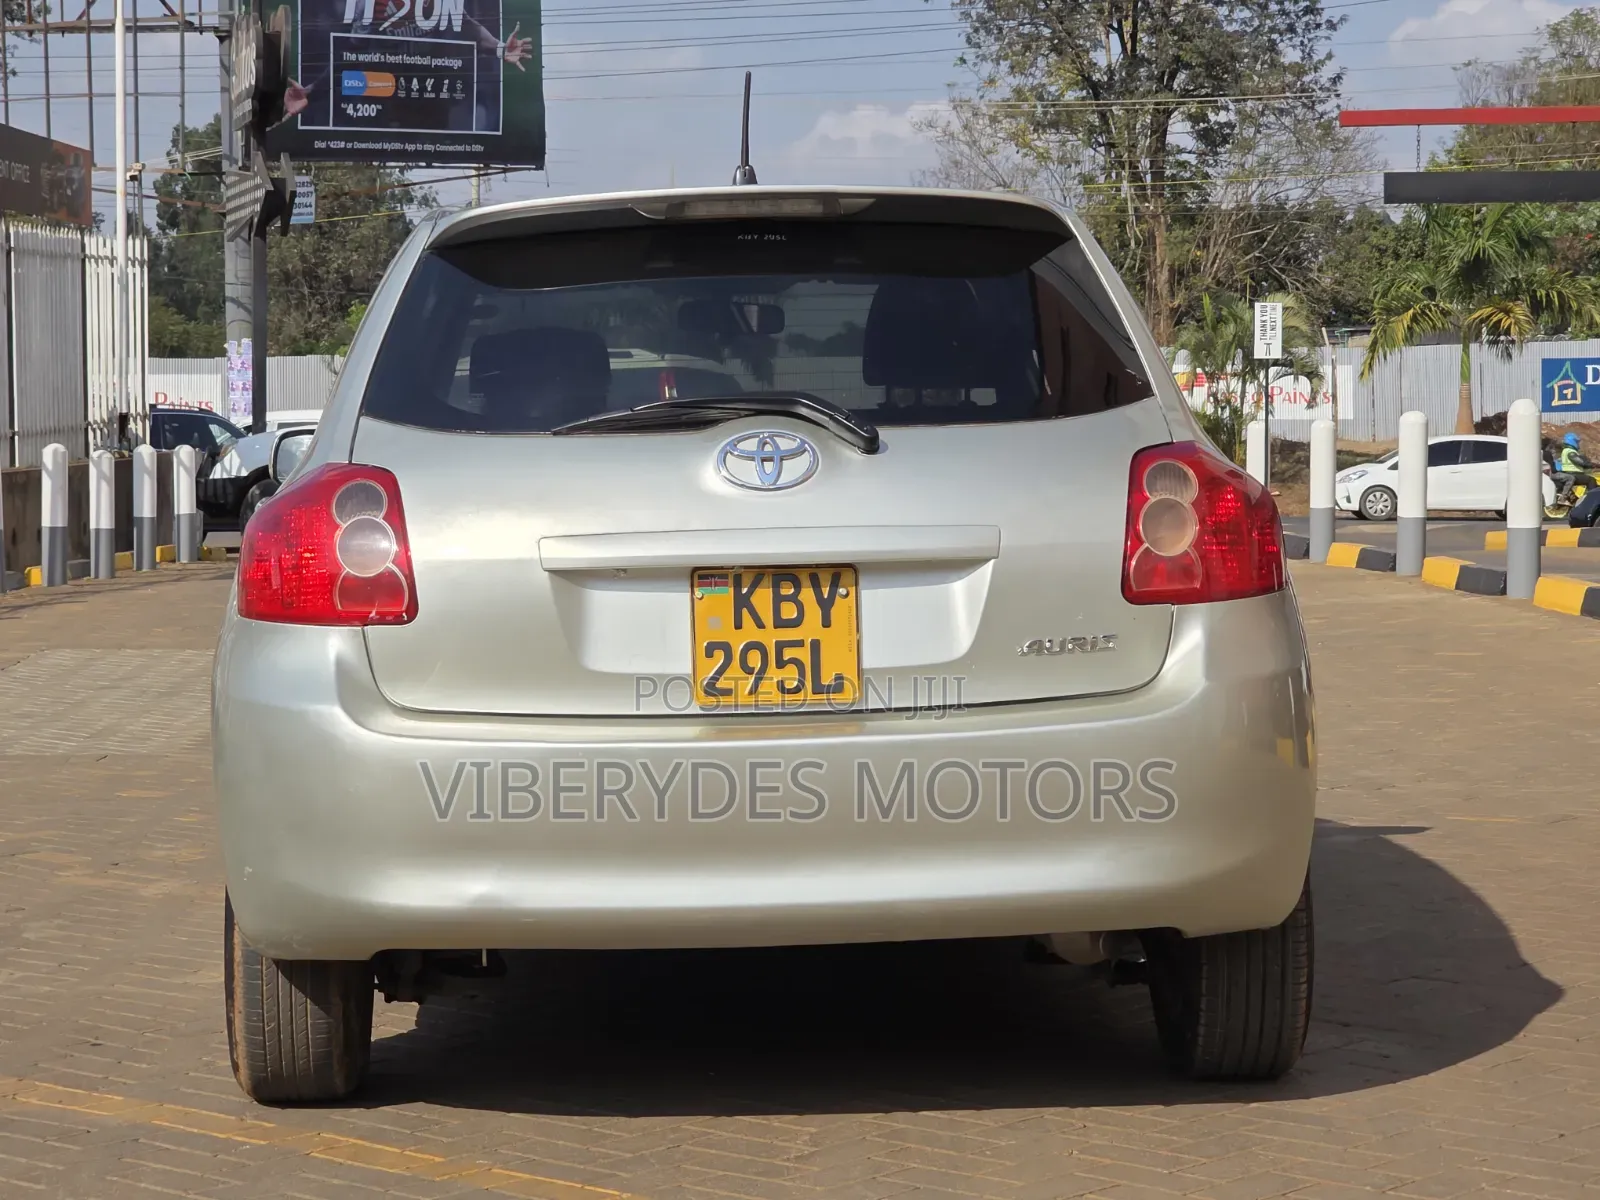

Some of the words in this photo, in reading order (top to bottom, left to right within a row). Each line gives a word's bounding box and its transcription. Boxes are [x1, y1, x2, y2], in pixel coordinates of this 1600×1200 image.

[343, 52, 356, 61] The
[357, 52, 385, 63] world's
[386, 53, 402, 64] best
[403, 54, 431, 65] football
[431, 56, 463, 69] package
[346, 103, 377, 118] 4,200
[314, 140, 327, 149] Dial
[353, 140, 382, 150] Download
[404, 142, 416, 152] App
[416, 143, 423, 151] to
[423, 143, 435, 153] stay
[435, 143, 465, 152] Connected
[465, 144, 472, 152] to
[1260, 304, 1268, 318] YOU
[1260, 319, 1268, 341] THANK
[732, 571, 842, 630] KBY
[1016, 634, 1118, 656] AURIS
[703, 638, 845, 697] 295L
